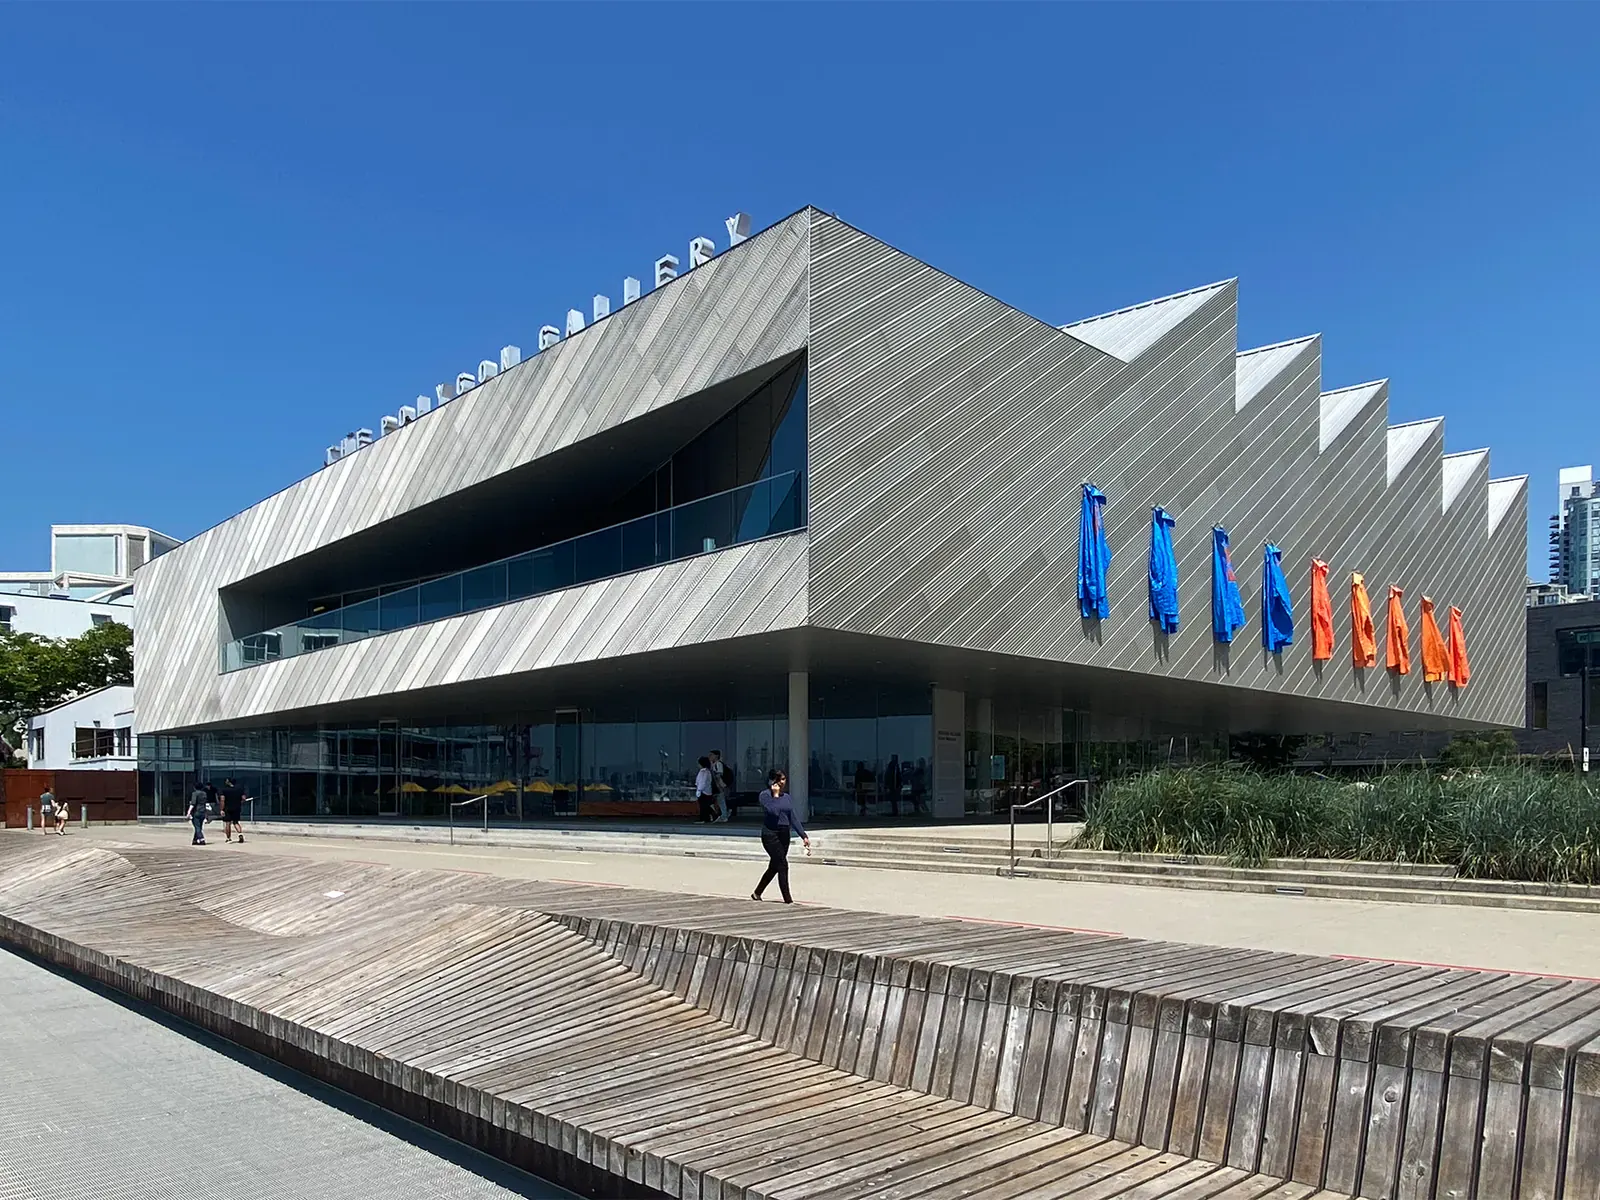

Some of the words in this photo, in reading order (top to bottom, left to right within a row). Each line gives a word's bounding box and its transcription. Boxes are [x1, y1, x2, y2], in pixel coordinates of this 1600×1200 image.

[326, 428, 373, 465] THE
[381, 345, 521, 437] POLYGON
[538, 212, 751, 350] GALLERY
